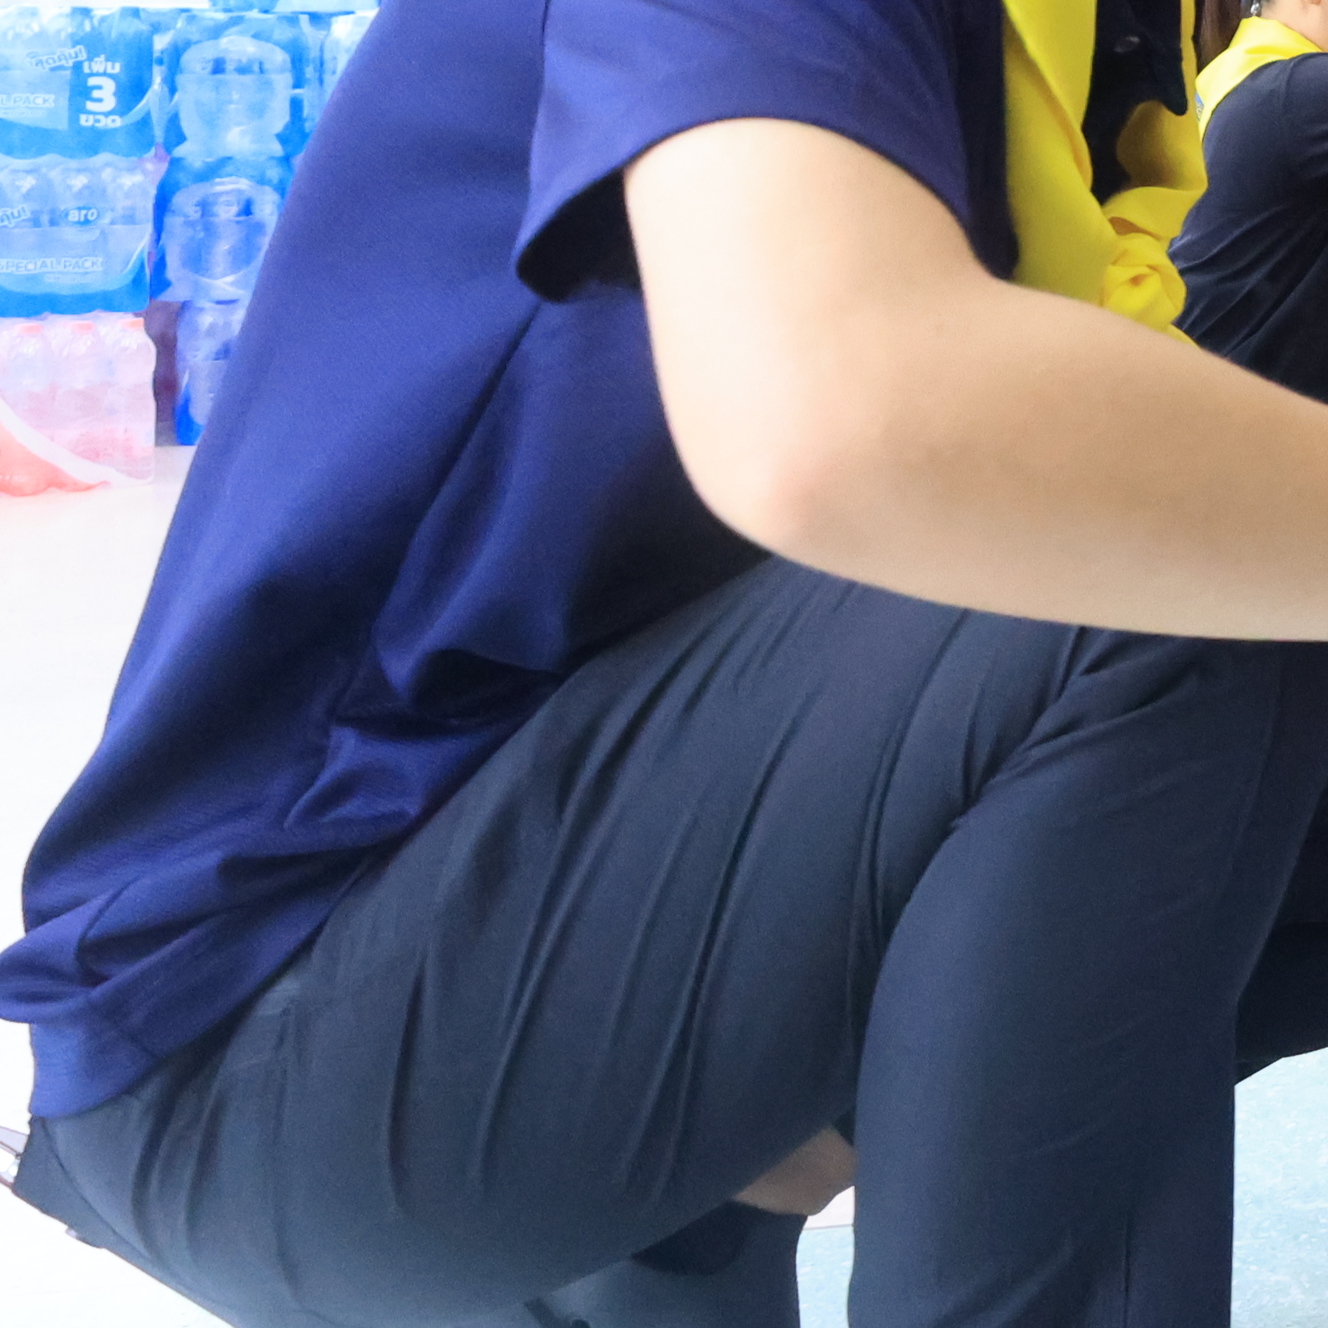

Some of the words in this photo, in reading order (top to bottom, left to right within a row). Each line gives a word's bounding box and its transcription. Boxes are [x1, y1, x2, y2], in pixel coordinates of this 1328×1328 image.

[82, 53, 122, 75] เพิ่ม
[84, 75, 117, 113] 3
[78, 113, 122, 129] ขวด
[66, 207, 99, 223] aro
